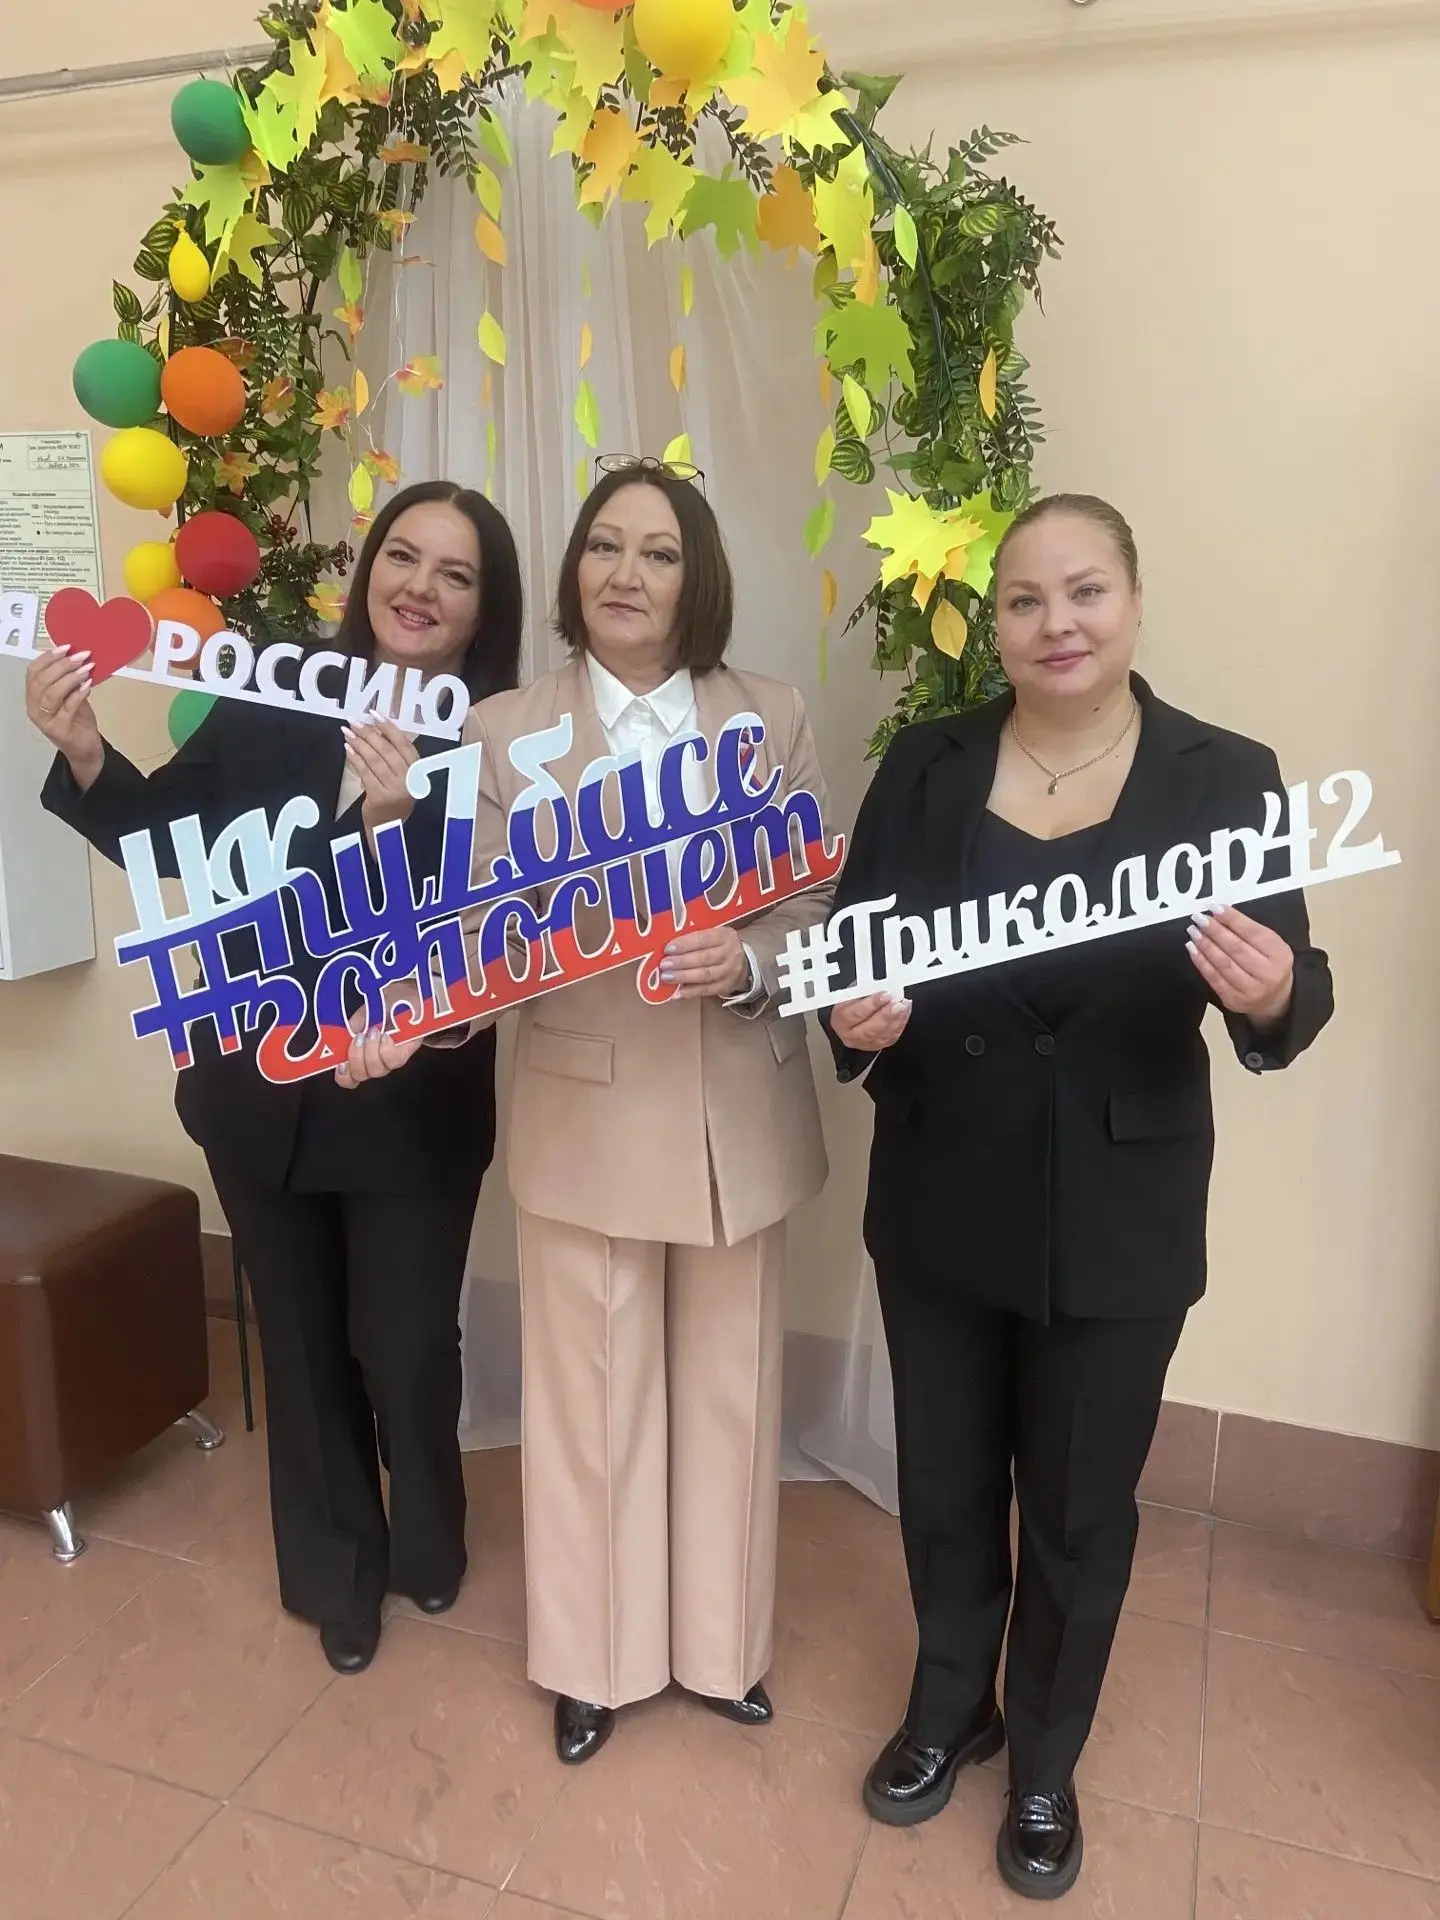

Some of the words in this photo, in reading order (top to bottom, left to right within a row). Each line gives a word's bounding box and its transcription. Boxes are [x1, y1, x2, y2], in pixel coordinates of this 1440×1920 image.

[0, 590, 39, 656] Я
[152, 618, 471, 742] РОССИЮ
[776, 768, 1402, 1018] #Триколор42
